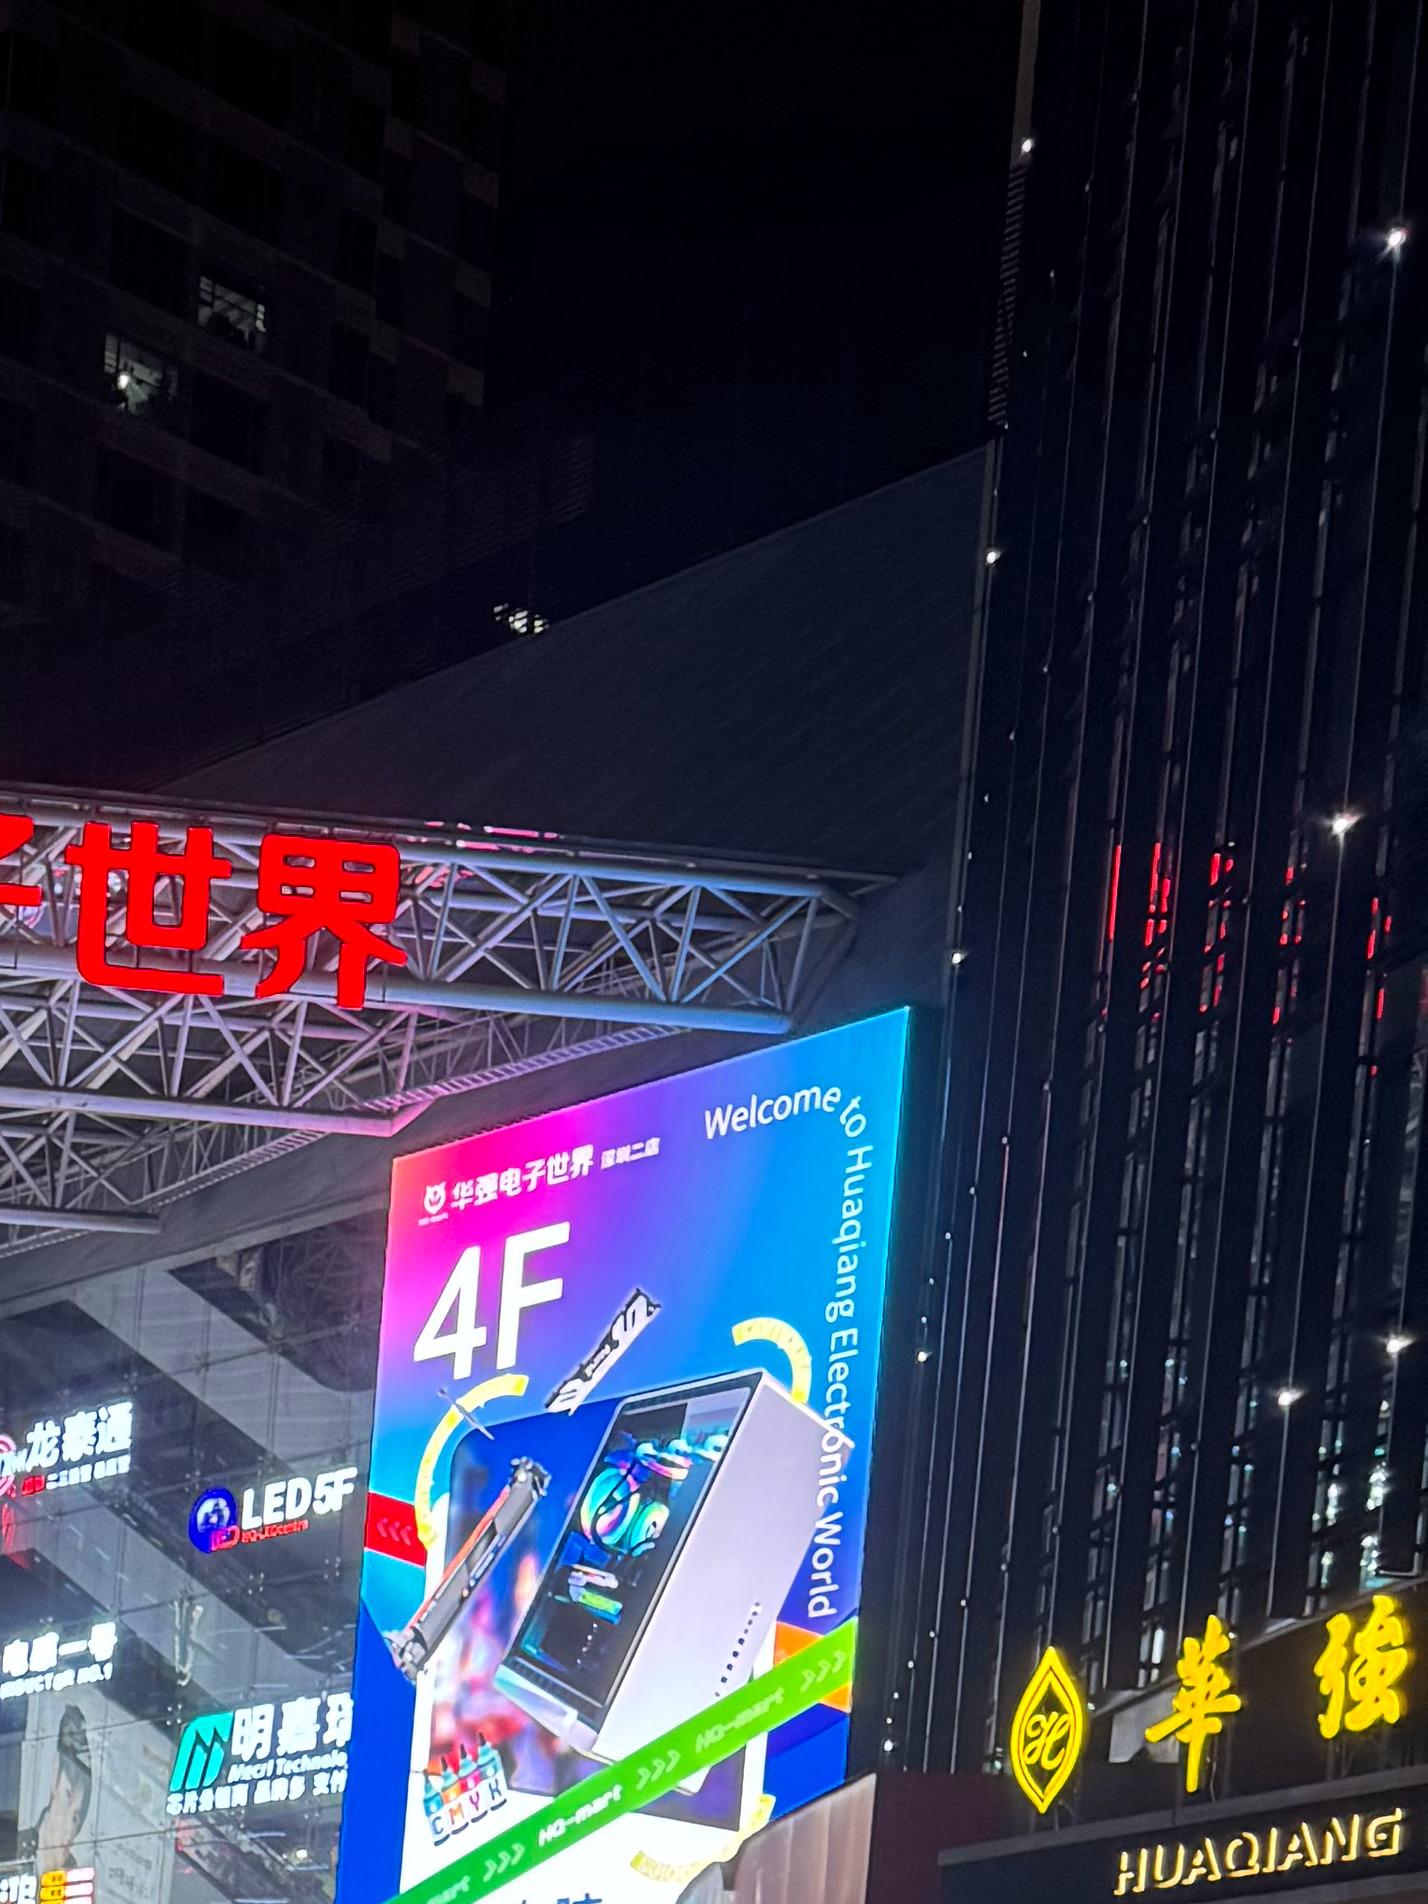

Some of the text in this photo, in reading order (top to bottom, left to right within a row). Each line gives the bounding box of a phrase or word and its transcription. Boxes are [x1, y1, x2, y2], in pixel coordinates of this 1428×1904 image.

[450, 1144, 594, 1211] 华强电子世界
[413, 1220, 572, 1382] 4F
[704, 1085, 873, 1620] Welcome to Huaqiang Electronic World
[1113, 1807, 1402, 1896] HUAQIANG
